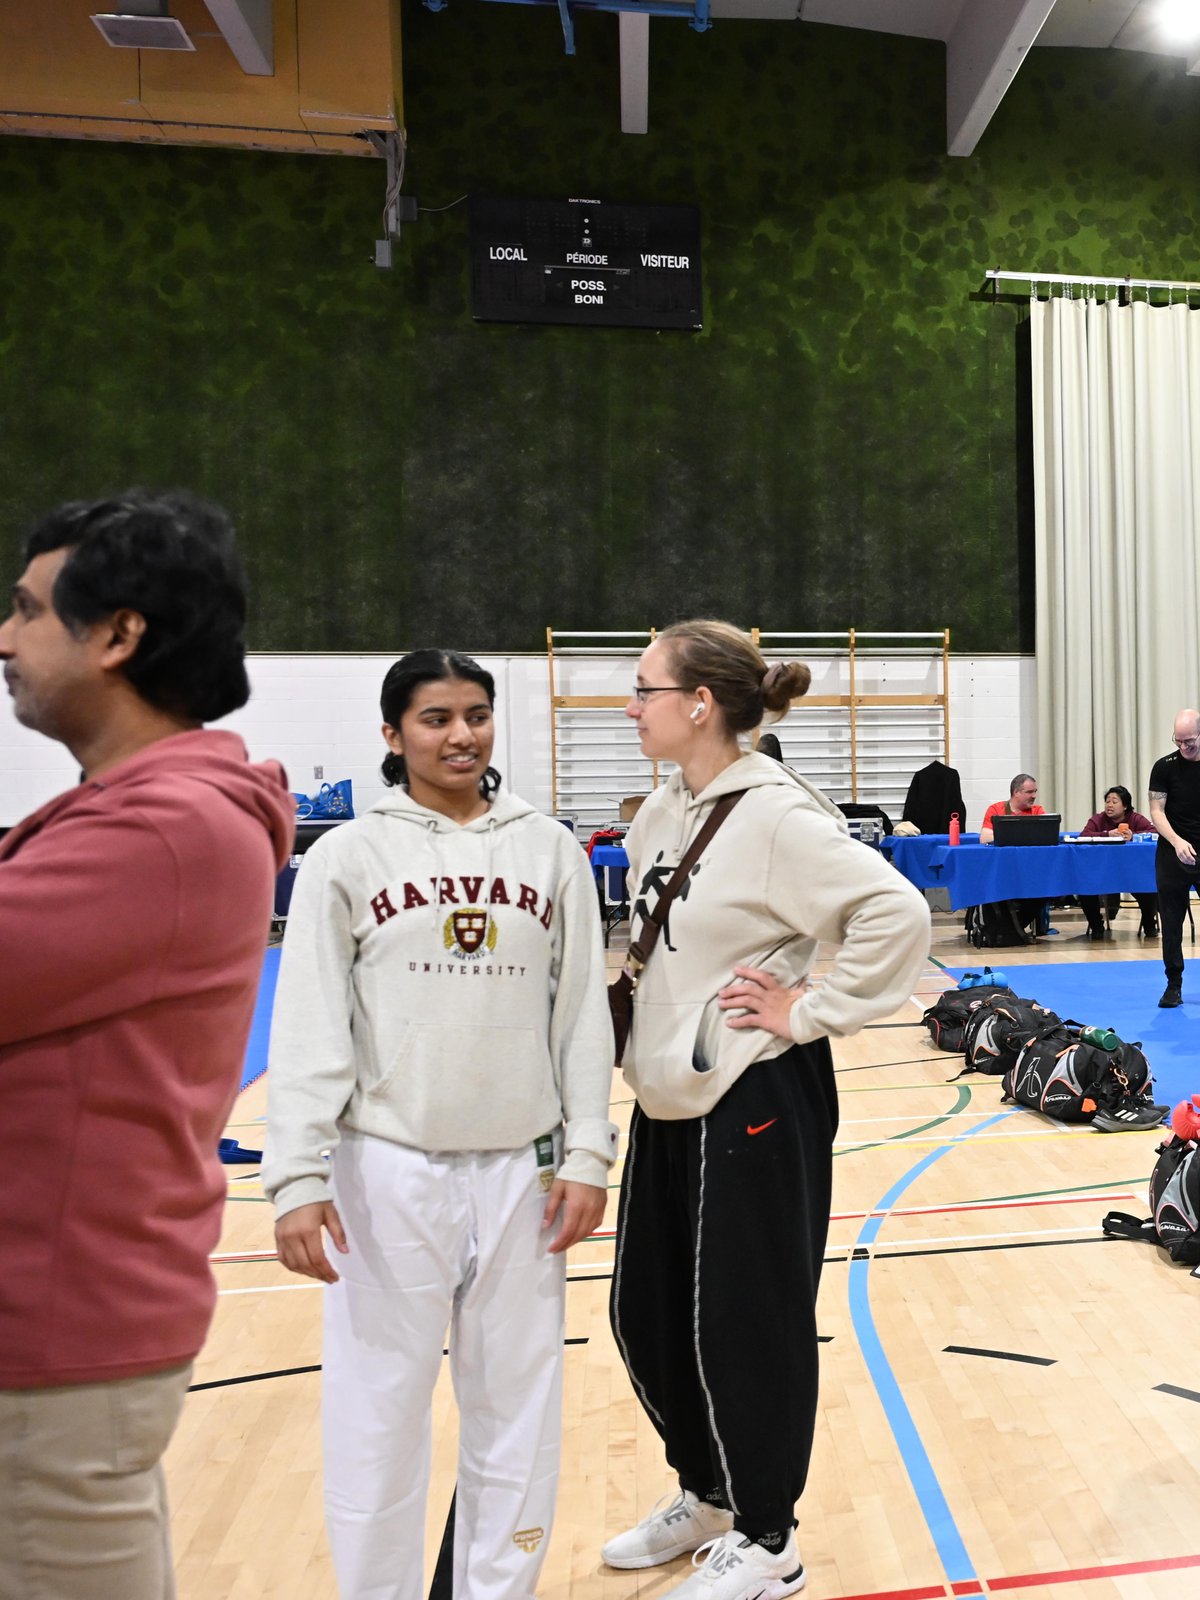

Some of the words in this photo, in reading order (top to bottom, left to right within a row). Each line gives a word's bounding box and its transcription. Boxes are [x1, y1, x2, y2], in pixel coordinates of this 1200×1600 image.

[489, 247, 528, 262] LOCAL
[566, 252, 609, 265] PÉRIODE
[640, 254, 690, 269] VISITEUR
[571, 280, 607, 292] POSS.
[574, 294, 604, 305] BONI
[409, 962, 527, 976] UNIVERSITY
